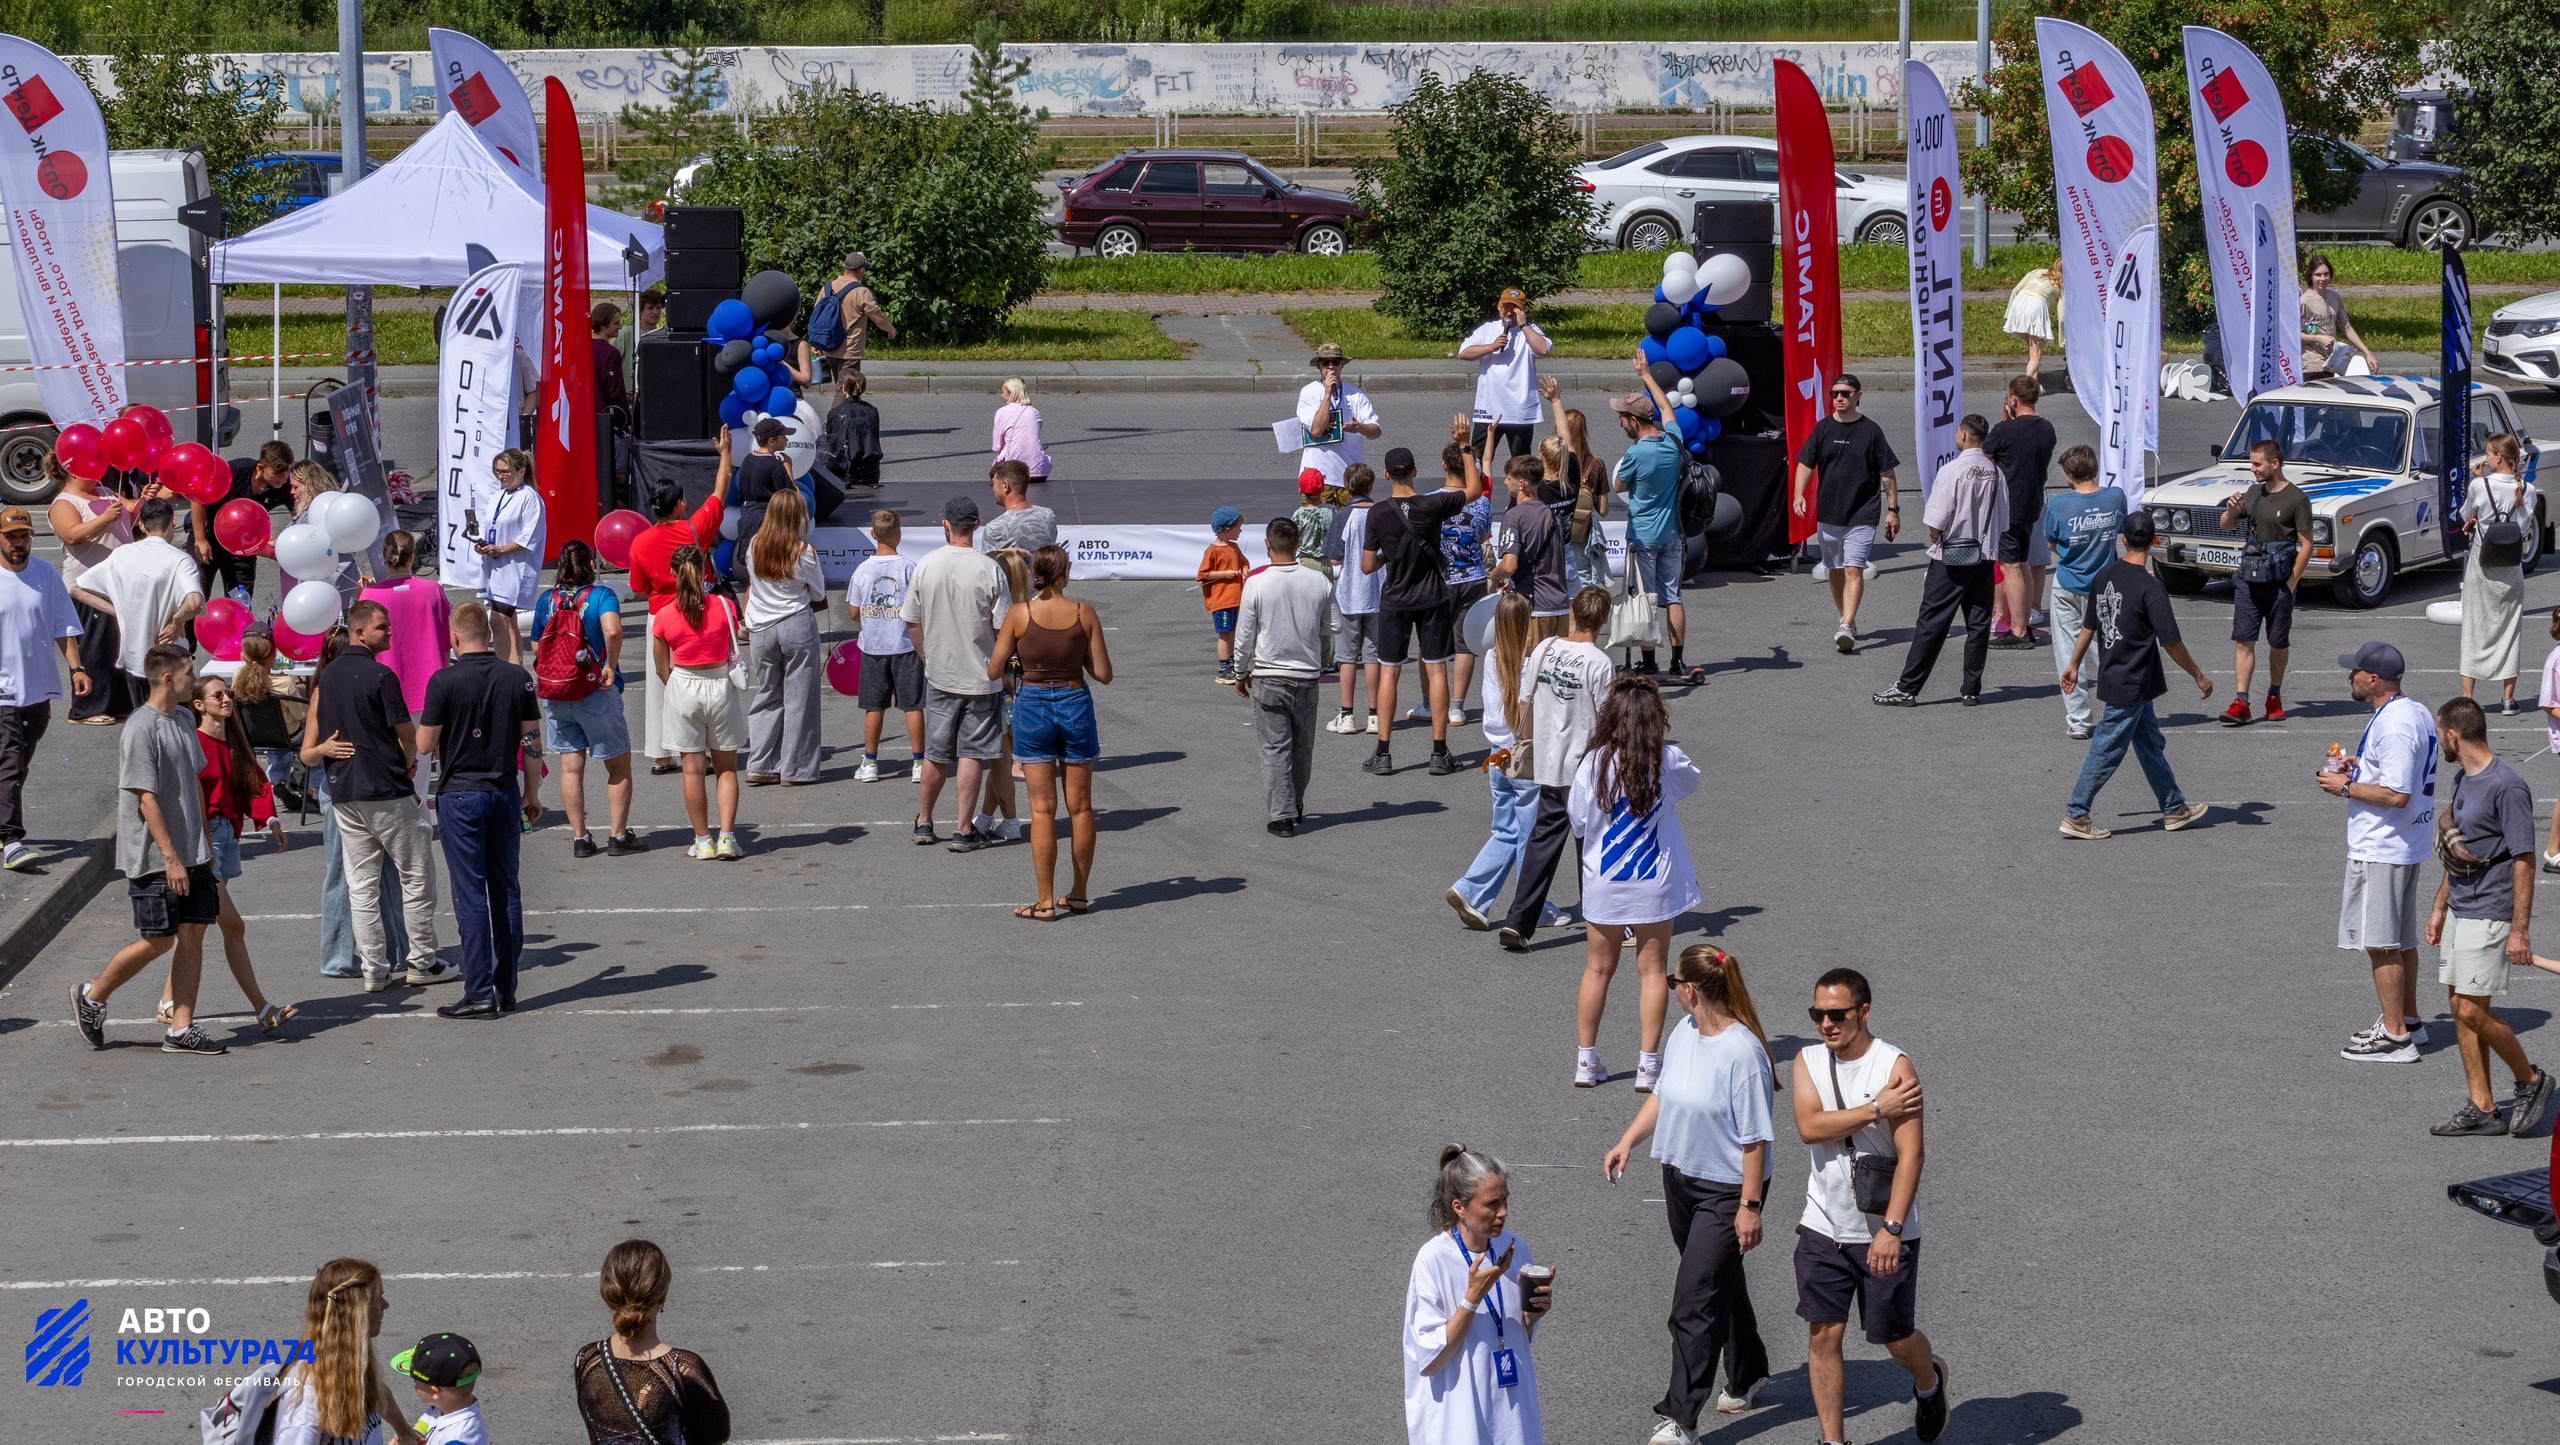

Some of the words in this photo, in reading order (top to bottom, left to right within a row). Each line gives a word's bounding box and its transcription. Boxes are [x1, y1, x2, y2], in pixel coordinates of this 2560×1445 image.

[1154, 70, 1194, 96] FIT
[2109, 320, 2124, 449] AUTO
[448, 360, 474, 499] AUTO
[446, 522, 458, 564] IN
[1077, 540, 1110, 549] АВТО
[1077, 551, 1153, 560] КУЛЬТУРА74
